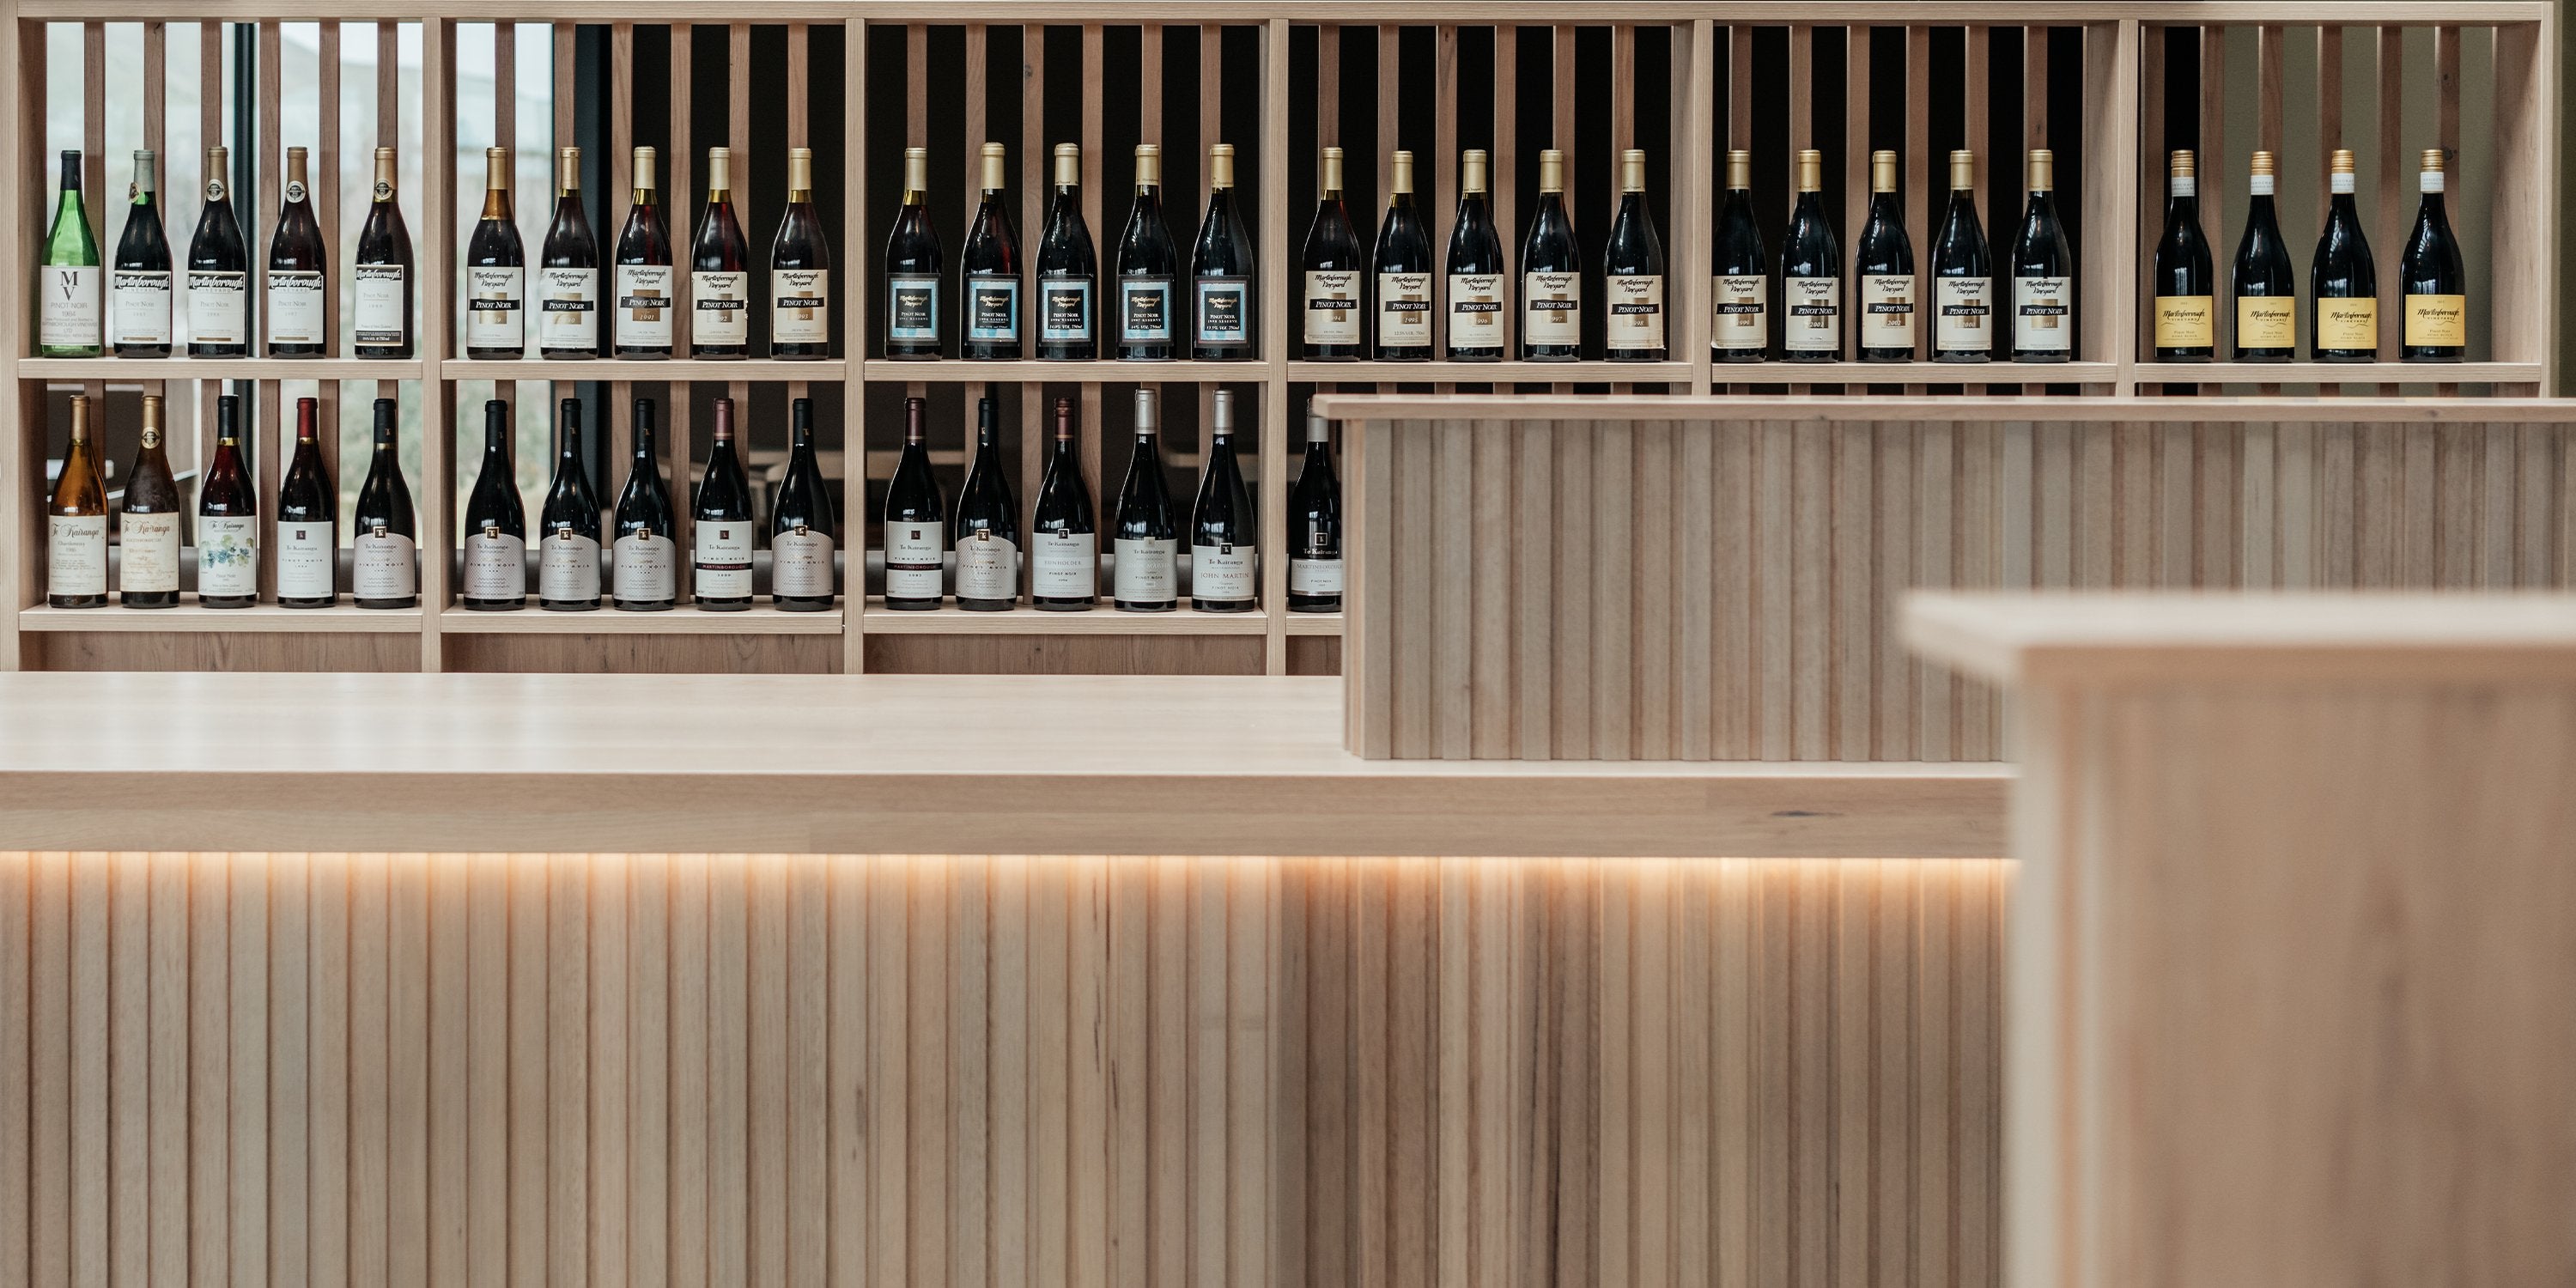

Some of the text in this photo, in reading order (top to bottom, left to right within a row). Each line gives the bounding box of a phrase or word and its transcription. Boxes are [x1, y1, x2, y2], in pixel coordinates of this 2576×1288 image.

[61, 271, 78, 286] M
[356, 269, 401, 280] Martinborough
[475, 272, 513, 283] Martinborough
[550, 271, 588, 283] Martinborough
[628, 269, 666, 277] Martinborough
[782, 273, 818, 283] Martinborough
[1315, 273, 1352, 283] Martinborough
[116, 275, 169, 289] Martinborough
[189, 276, 244, 289] Martinborough
[269, 276, 322, 290] Martinborough
[702, 275, 738, 285] Martinborough
[1391, 276, 1426, 284] Martinborough
[1461, 277, 1498, 287] Martinborough
[1536, 275, 1573, 285] Martinborough
[1617, 278, 1654, 289] Martinborough
[1722, 278, 1760, 288] Martinborough
[1797, 280, 1833, 289] Martinborough
[1874, 278, 1911, 287] Martinborough
[1948, 280, 1985, 290] Martinborough
[2026, 280, 2063, 290] Martinborough
[64, 287, 75, 301] V
[2163, 308, 2205, 322] Martinborough
[2251, 310, 2291, 322] Martinborough
[2330, 311, 2372, 323] Martinborough
[2417, 307, 2459, 320] Martinborough
[61, 524, 99, 538] Kairanga
[133, 520, 170, 536] Kairanga
